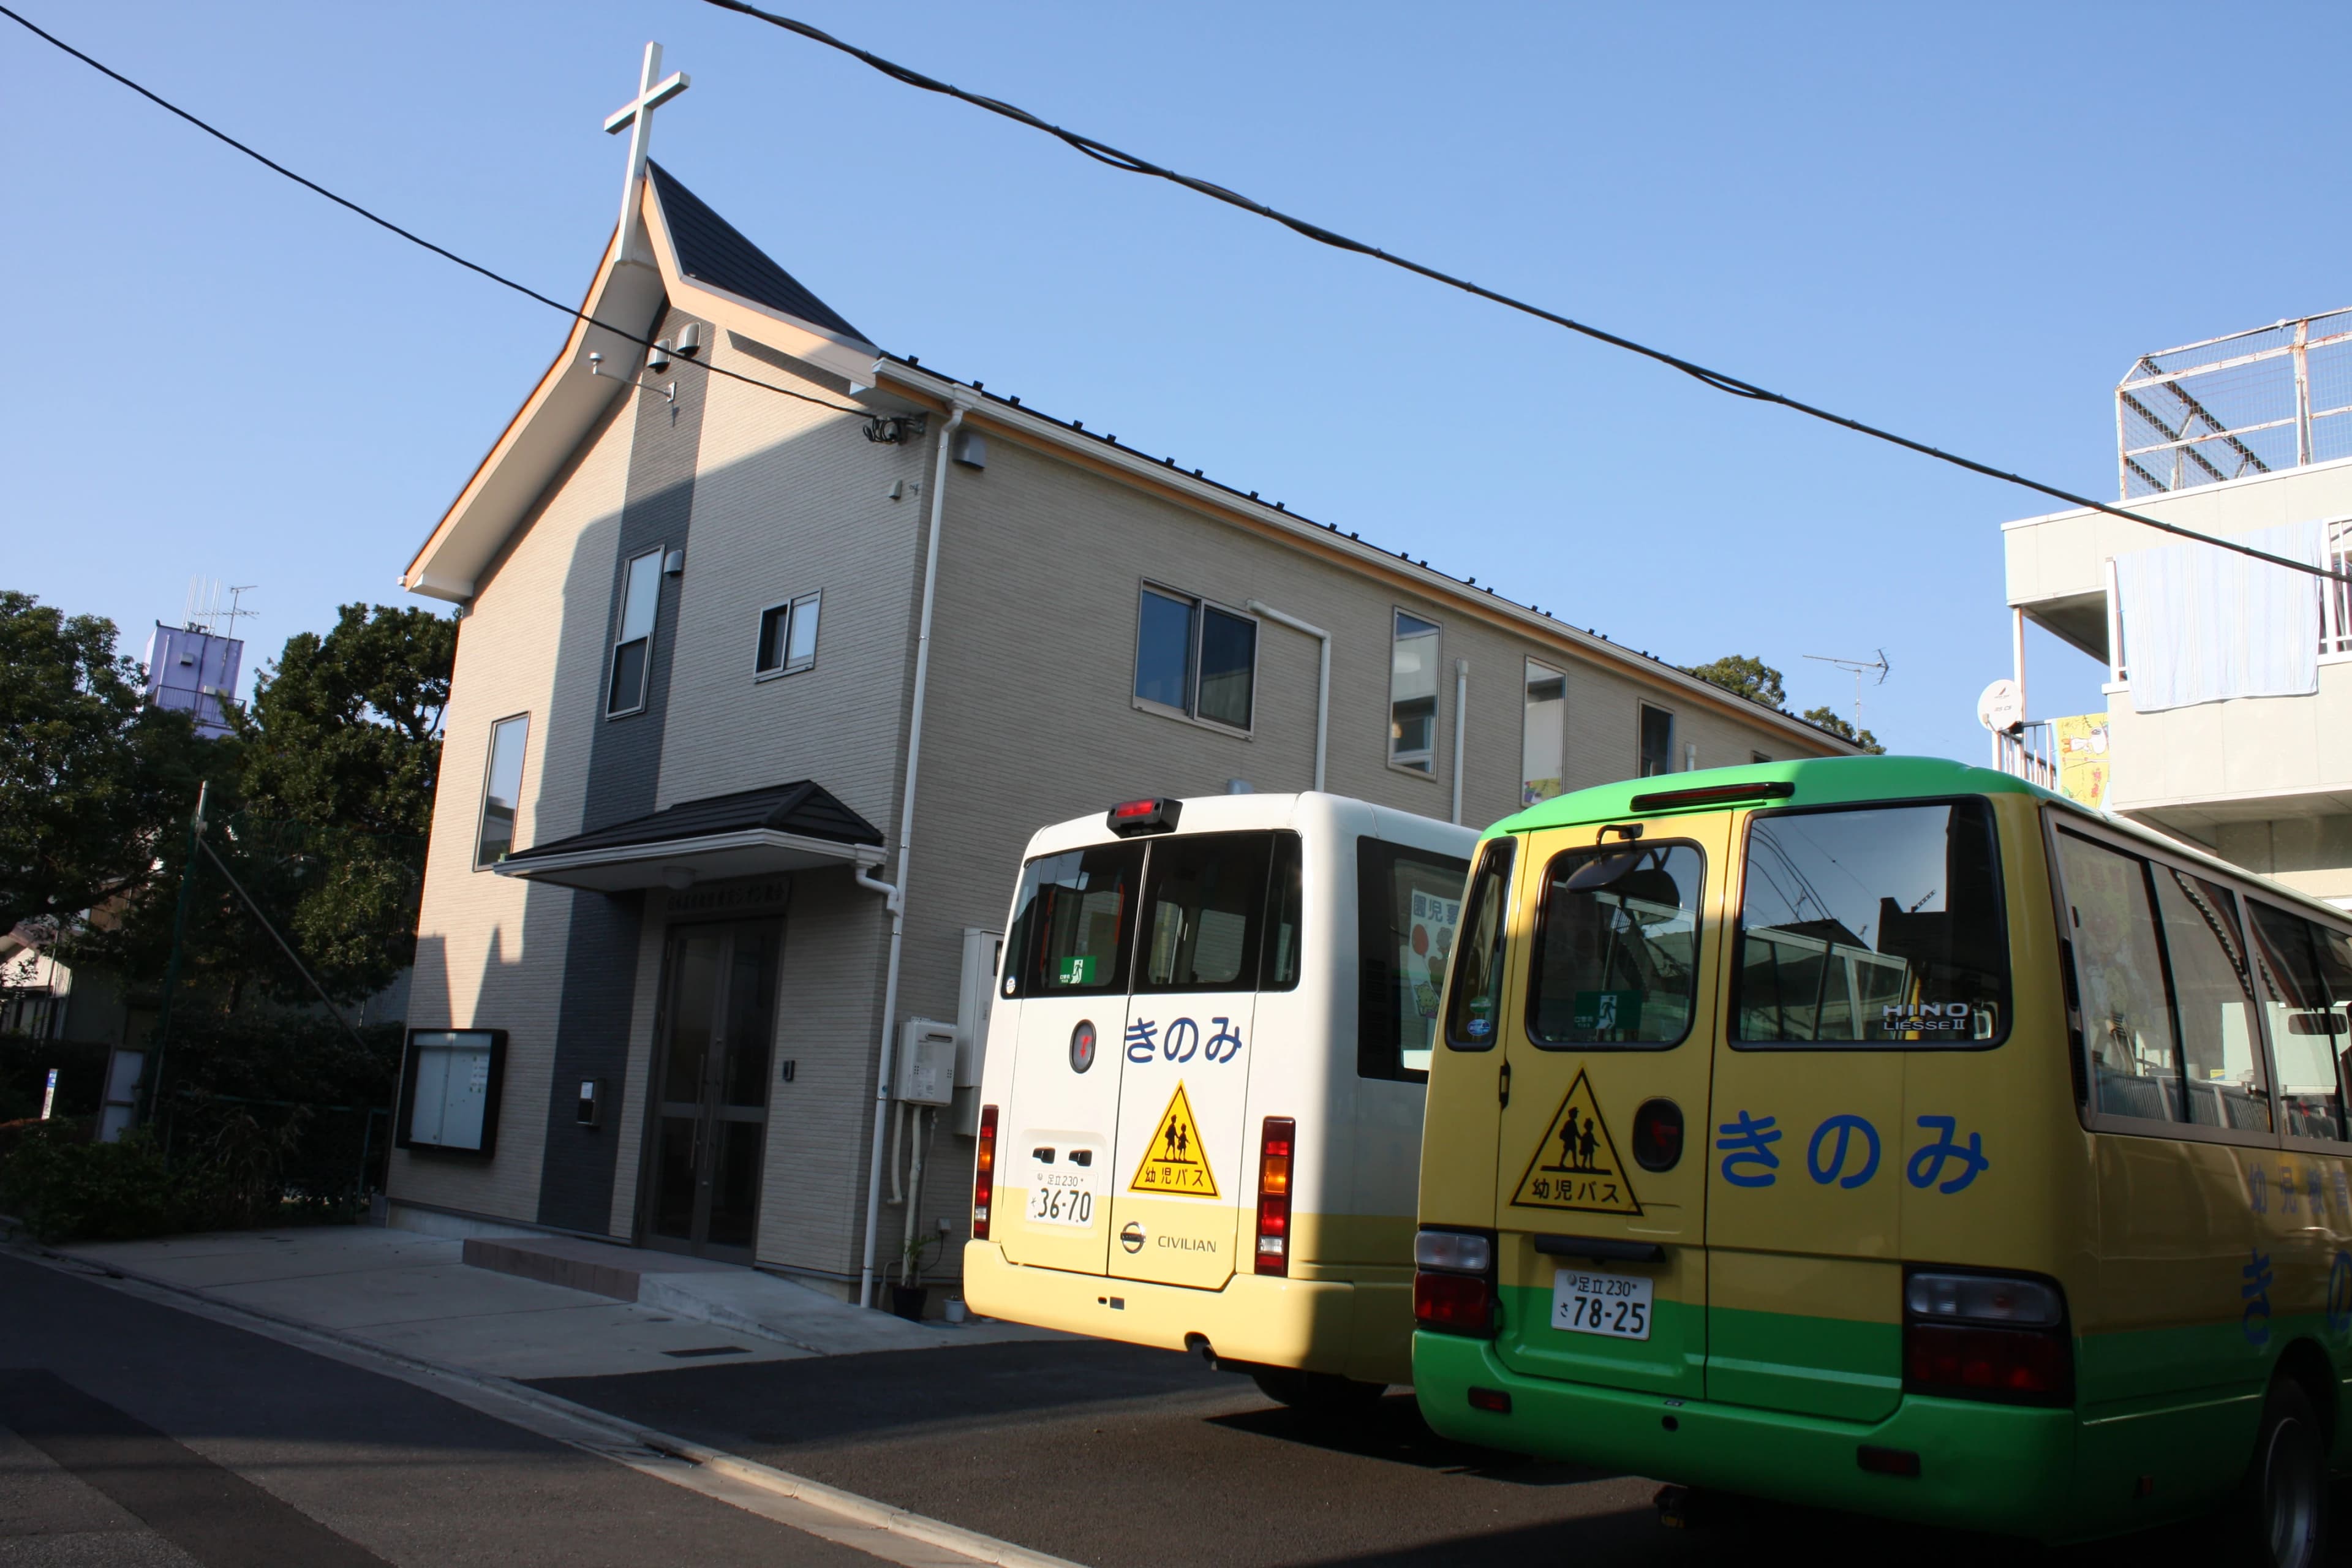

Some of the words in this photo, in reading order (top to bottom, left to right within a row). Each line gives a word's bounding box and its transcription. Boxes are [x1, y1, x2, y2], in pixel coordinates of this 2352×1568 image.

[1882, 1003, 1969, 1017] HINO
[1126, 1017, 1242, 1064] きのみ
[1716, 1110, 1989, 1194] きのみ
[1145, 1166, 1204, 1188] 幼児バス
[1532, 1178, 1619, 1204] 幼児バス
[1158, 1235, 1216, 1253] CIVILIAN
[1574, 1296, 1646, 1333] 78-25
